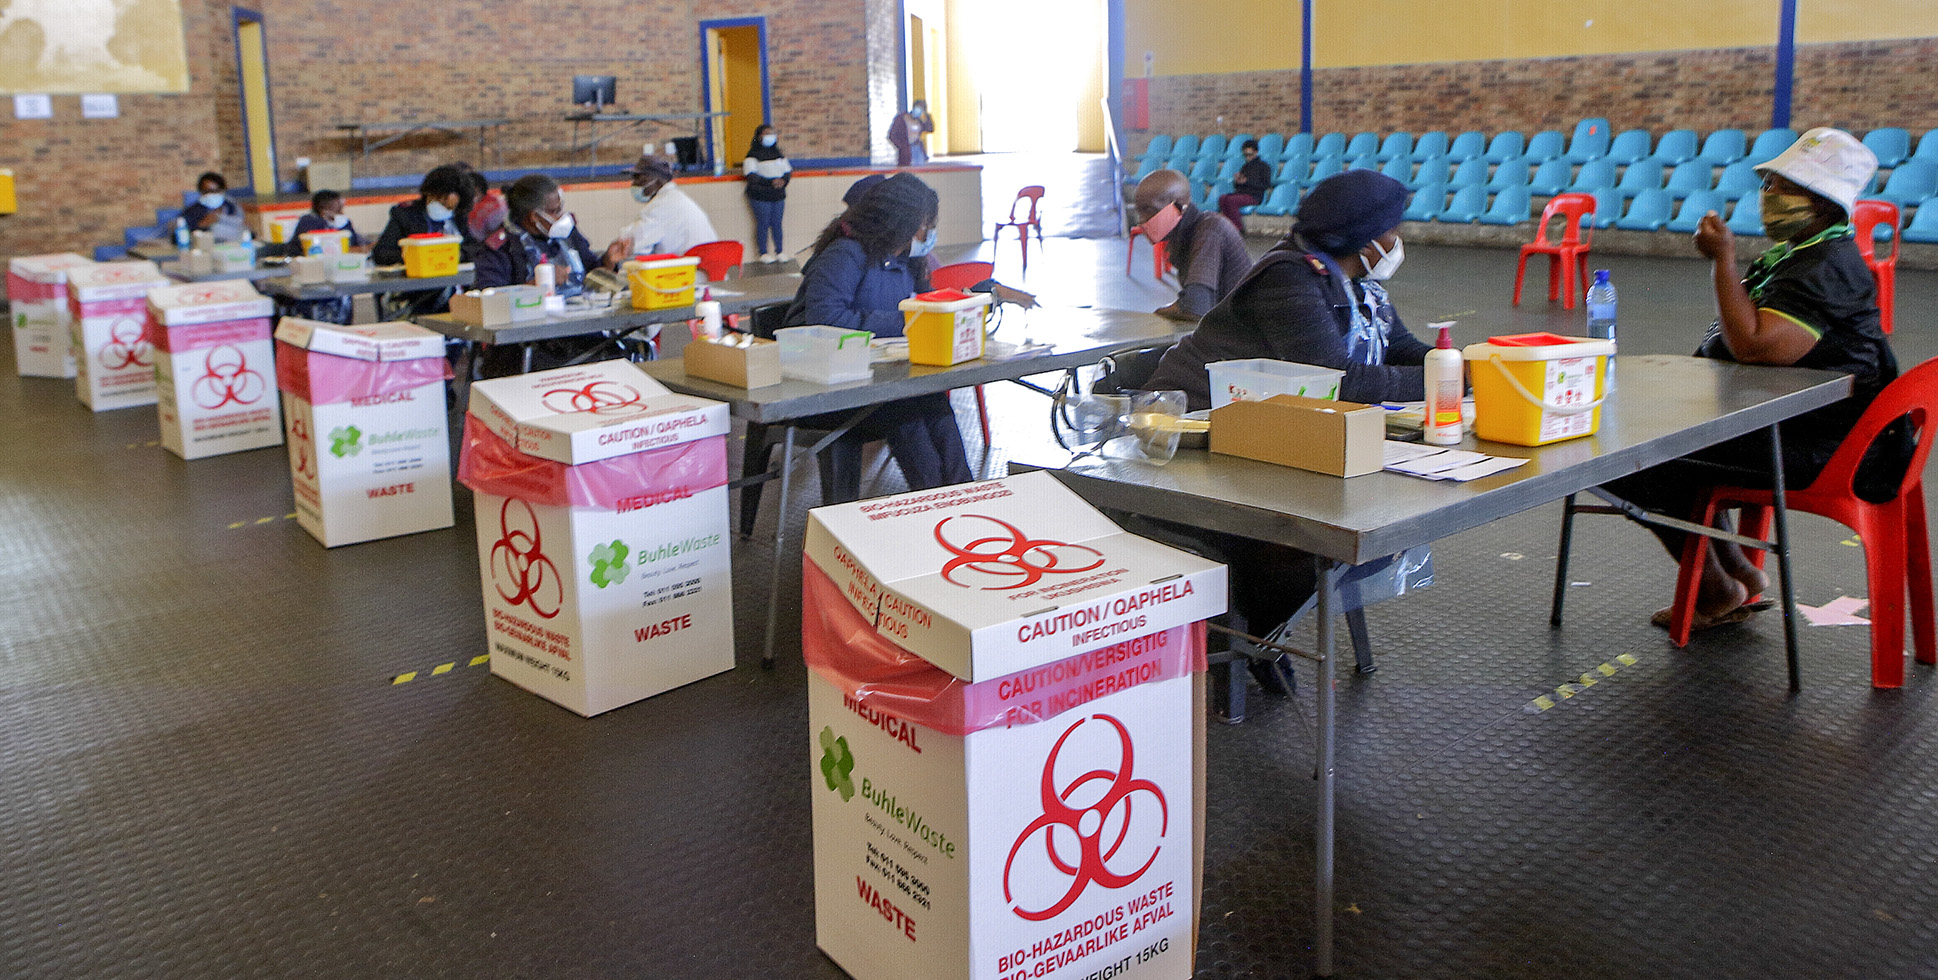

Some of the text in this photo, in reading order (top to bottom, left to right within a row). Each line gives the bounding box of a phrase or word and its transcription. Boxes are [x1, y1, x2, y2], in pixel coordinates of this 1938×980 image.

[598, 425, 649, 446] CAUTION
[632, 433, 680, 450] INFECTIOUS
[366, 482, 415, 499] WASTE
[616, 485, 693, 514] MEDICAL
[964, 481, 1006, 496] WASTE
[637, 533, 721, 566] BuhleWaste
[884, 594, 933, 629] CAUTION
[1008, 590, 1040, 601] FOR
[1018, 580, 1195, 643] CAUTION / QAPHELA
[634, 613, 692, 643] WASTE
[1072, 615, 1147, 647] INFECTIOUS
[998, 631, 1168, 701] CAUTION/VERSIGTIG
[1006, 658, 1162, 729] FOR INCINERATION
[861, 777, 956, 860] BuhleWaste
[856, 875, 917, 942] WASTE
[998, 881, 1174, 974] BIO-HAZARDOUS WASTE
[999, 902, 1174, 980] O-GEVAARLIKE AFVAL
[1136, 937, 1169, 965] 15KG
